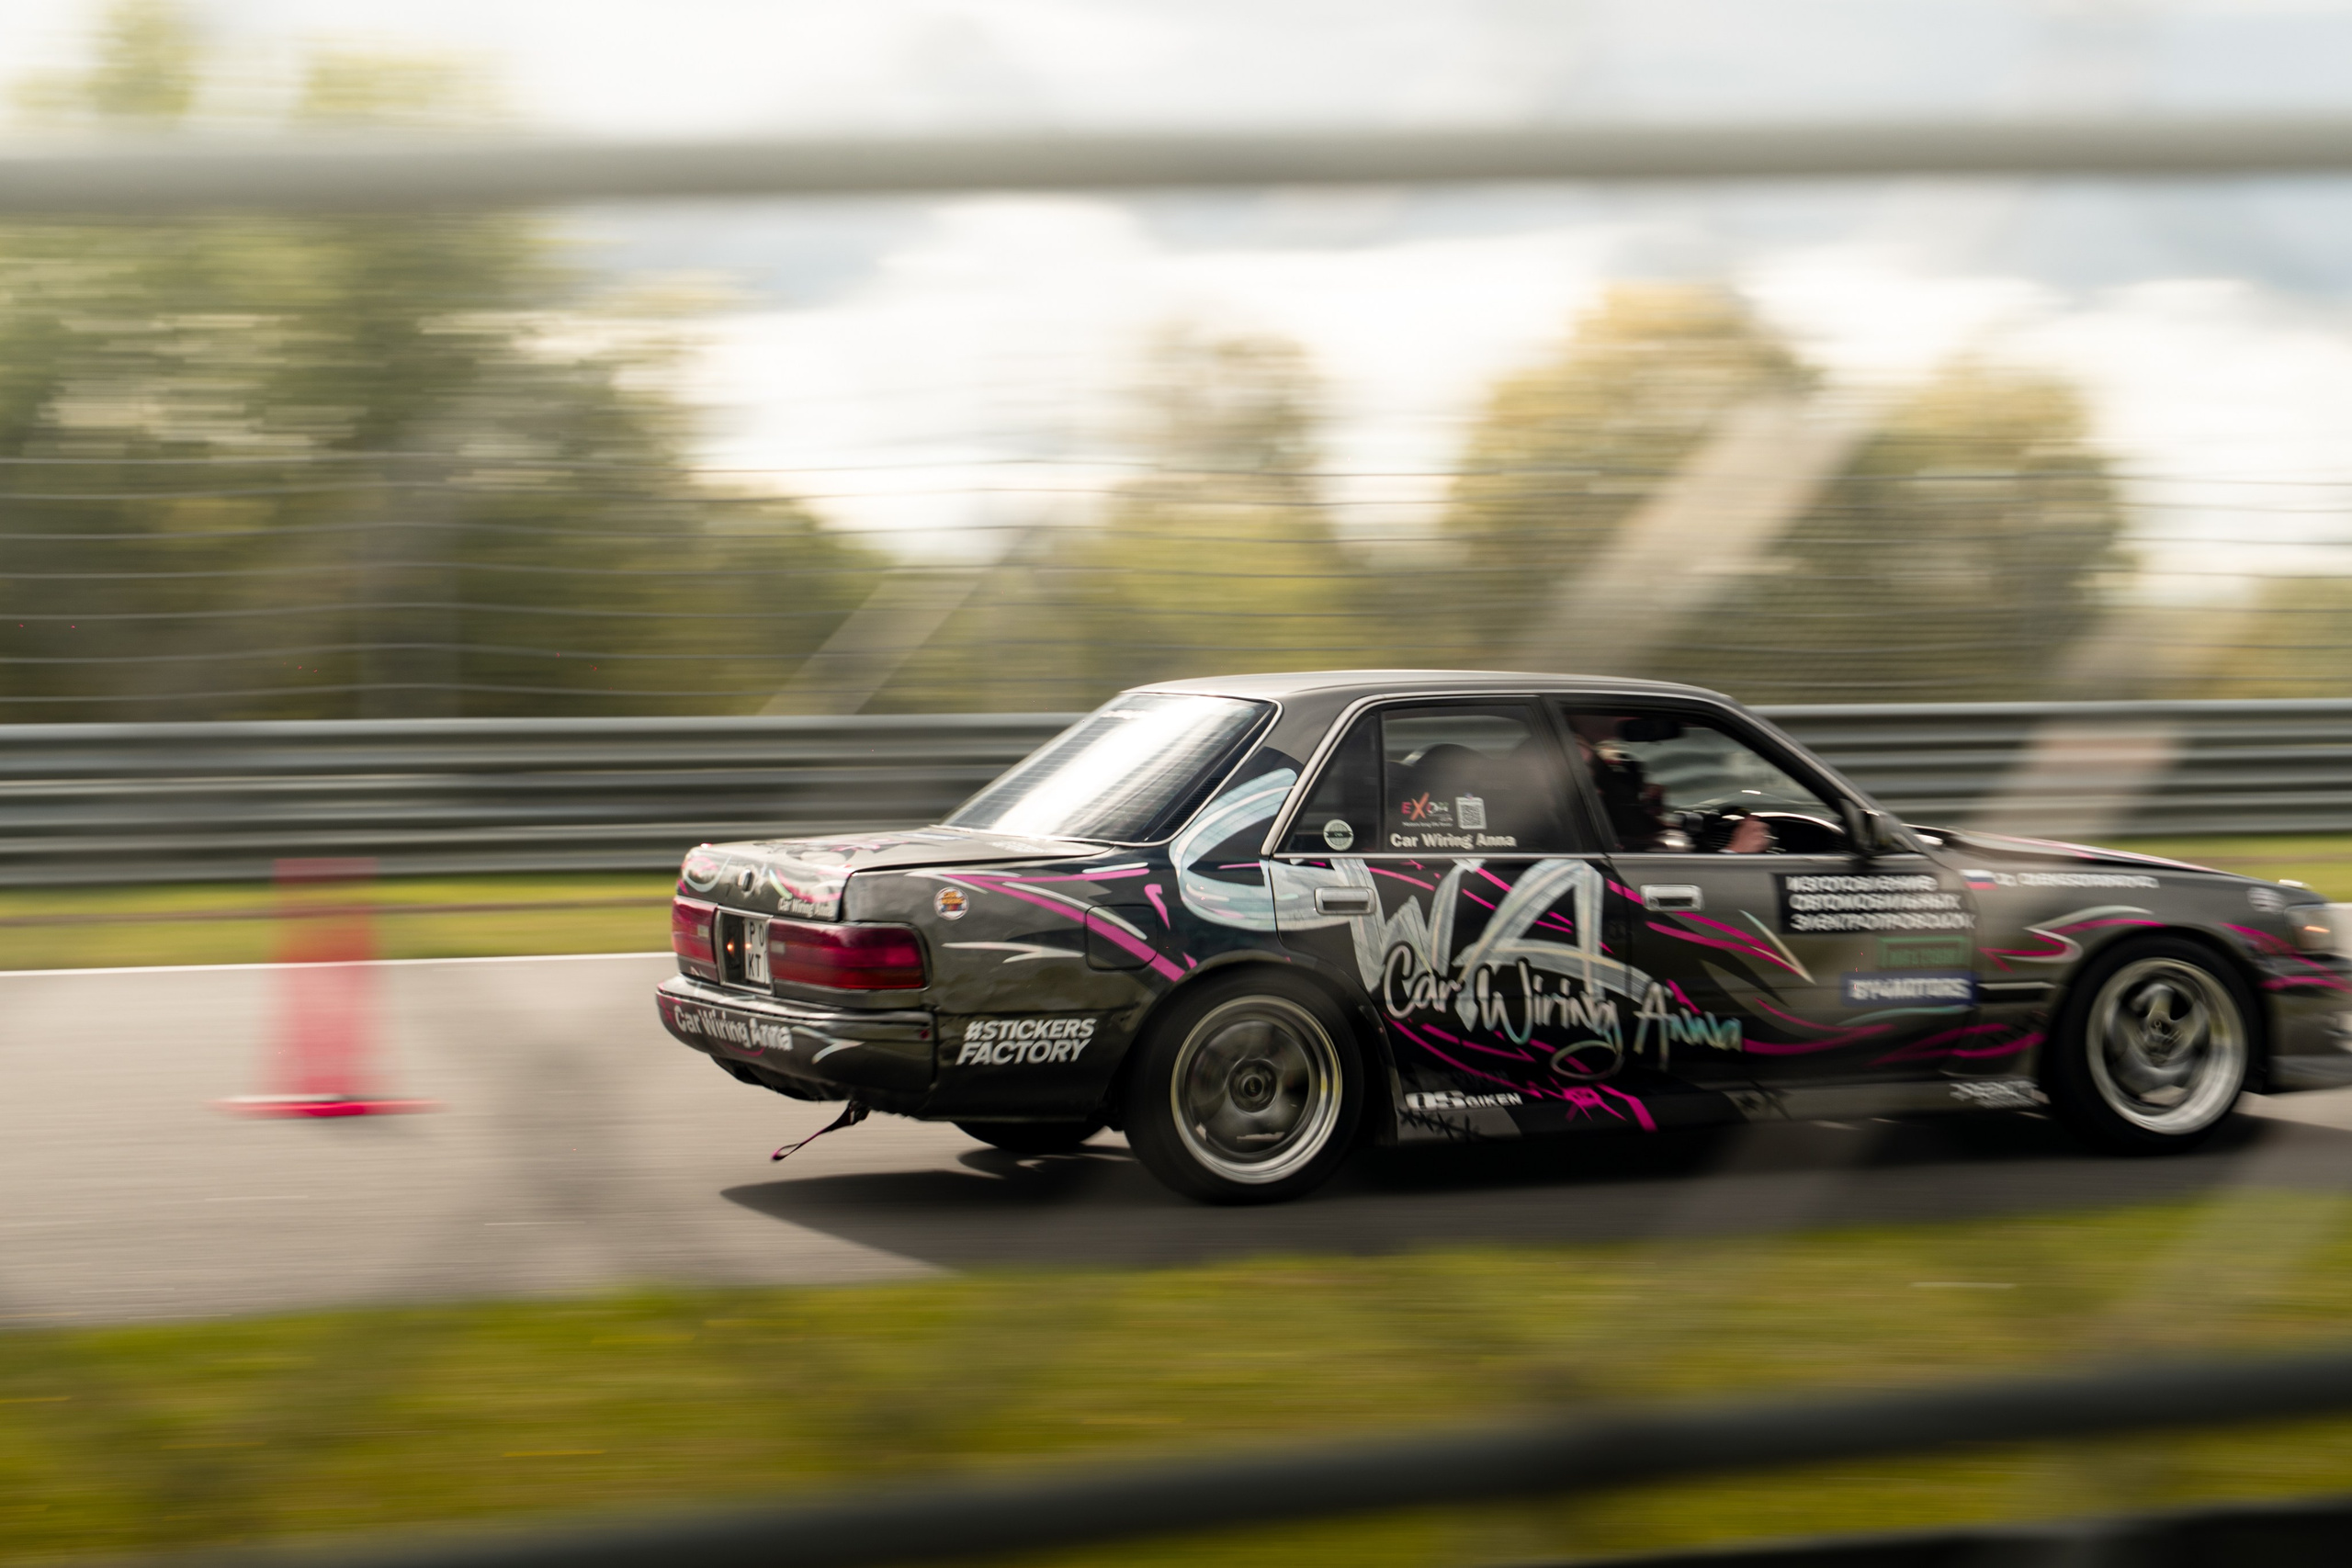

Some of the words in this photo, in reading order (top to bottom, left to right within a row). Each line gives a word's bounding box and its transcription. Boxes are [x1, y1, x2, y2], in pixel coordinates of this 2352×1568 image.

[1390, 832, 1419, 847] Car
[1420, 832, 1475, 850] Wiring
[1476, 832, 1517, 847] Anna
[777, 897, 791, 911] Car
[1384, 942, 1462, 1019] Car
[1475, 957, 1623, 1079] Wiring
[1634, 981, 1743, 1072] Anna
[674, 1005, 702, 1033] Car
[697, 1009, 752, 1048] Wiring
[750, 1017, 793, 1051] Anna
[964, 1018, 1097, 1042] #STICKERS
[956, 1038, 1091, 1066] FACTORY
[1406, 1090, 1467, 1111] OS
[1464, 1092, 1523, 1108] GIKEN
